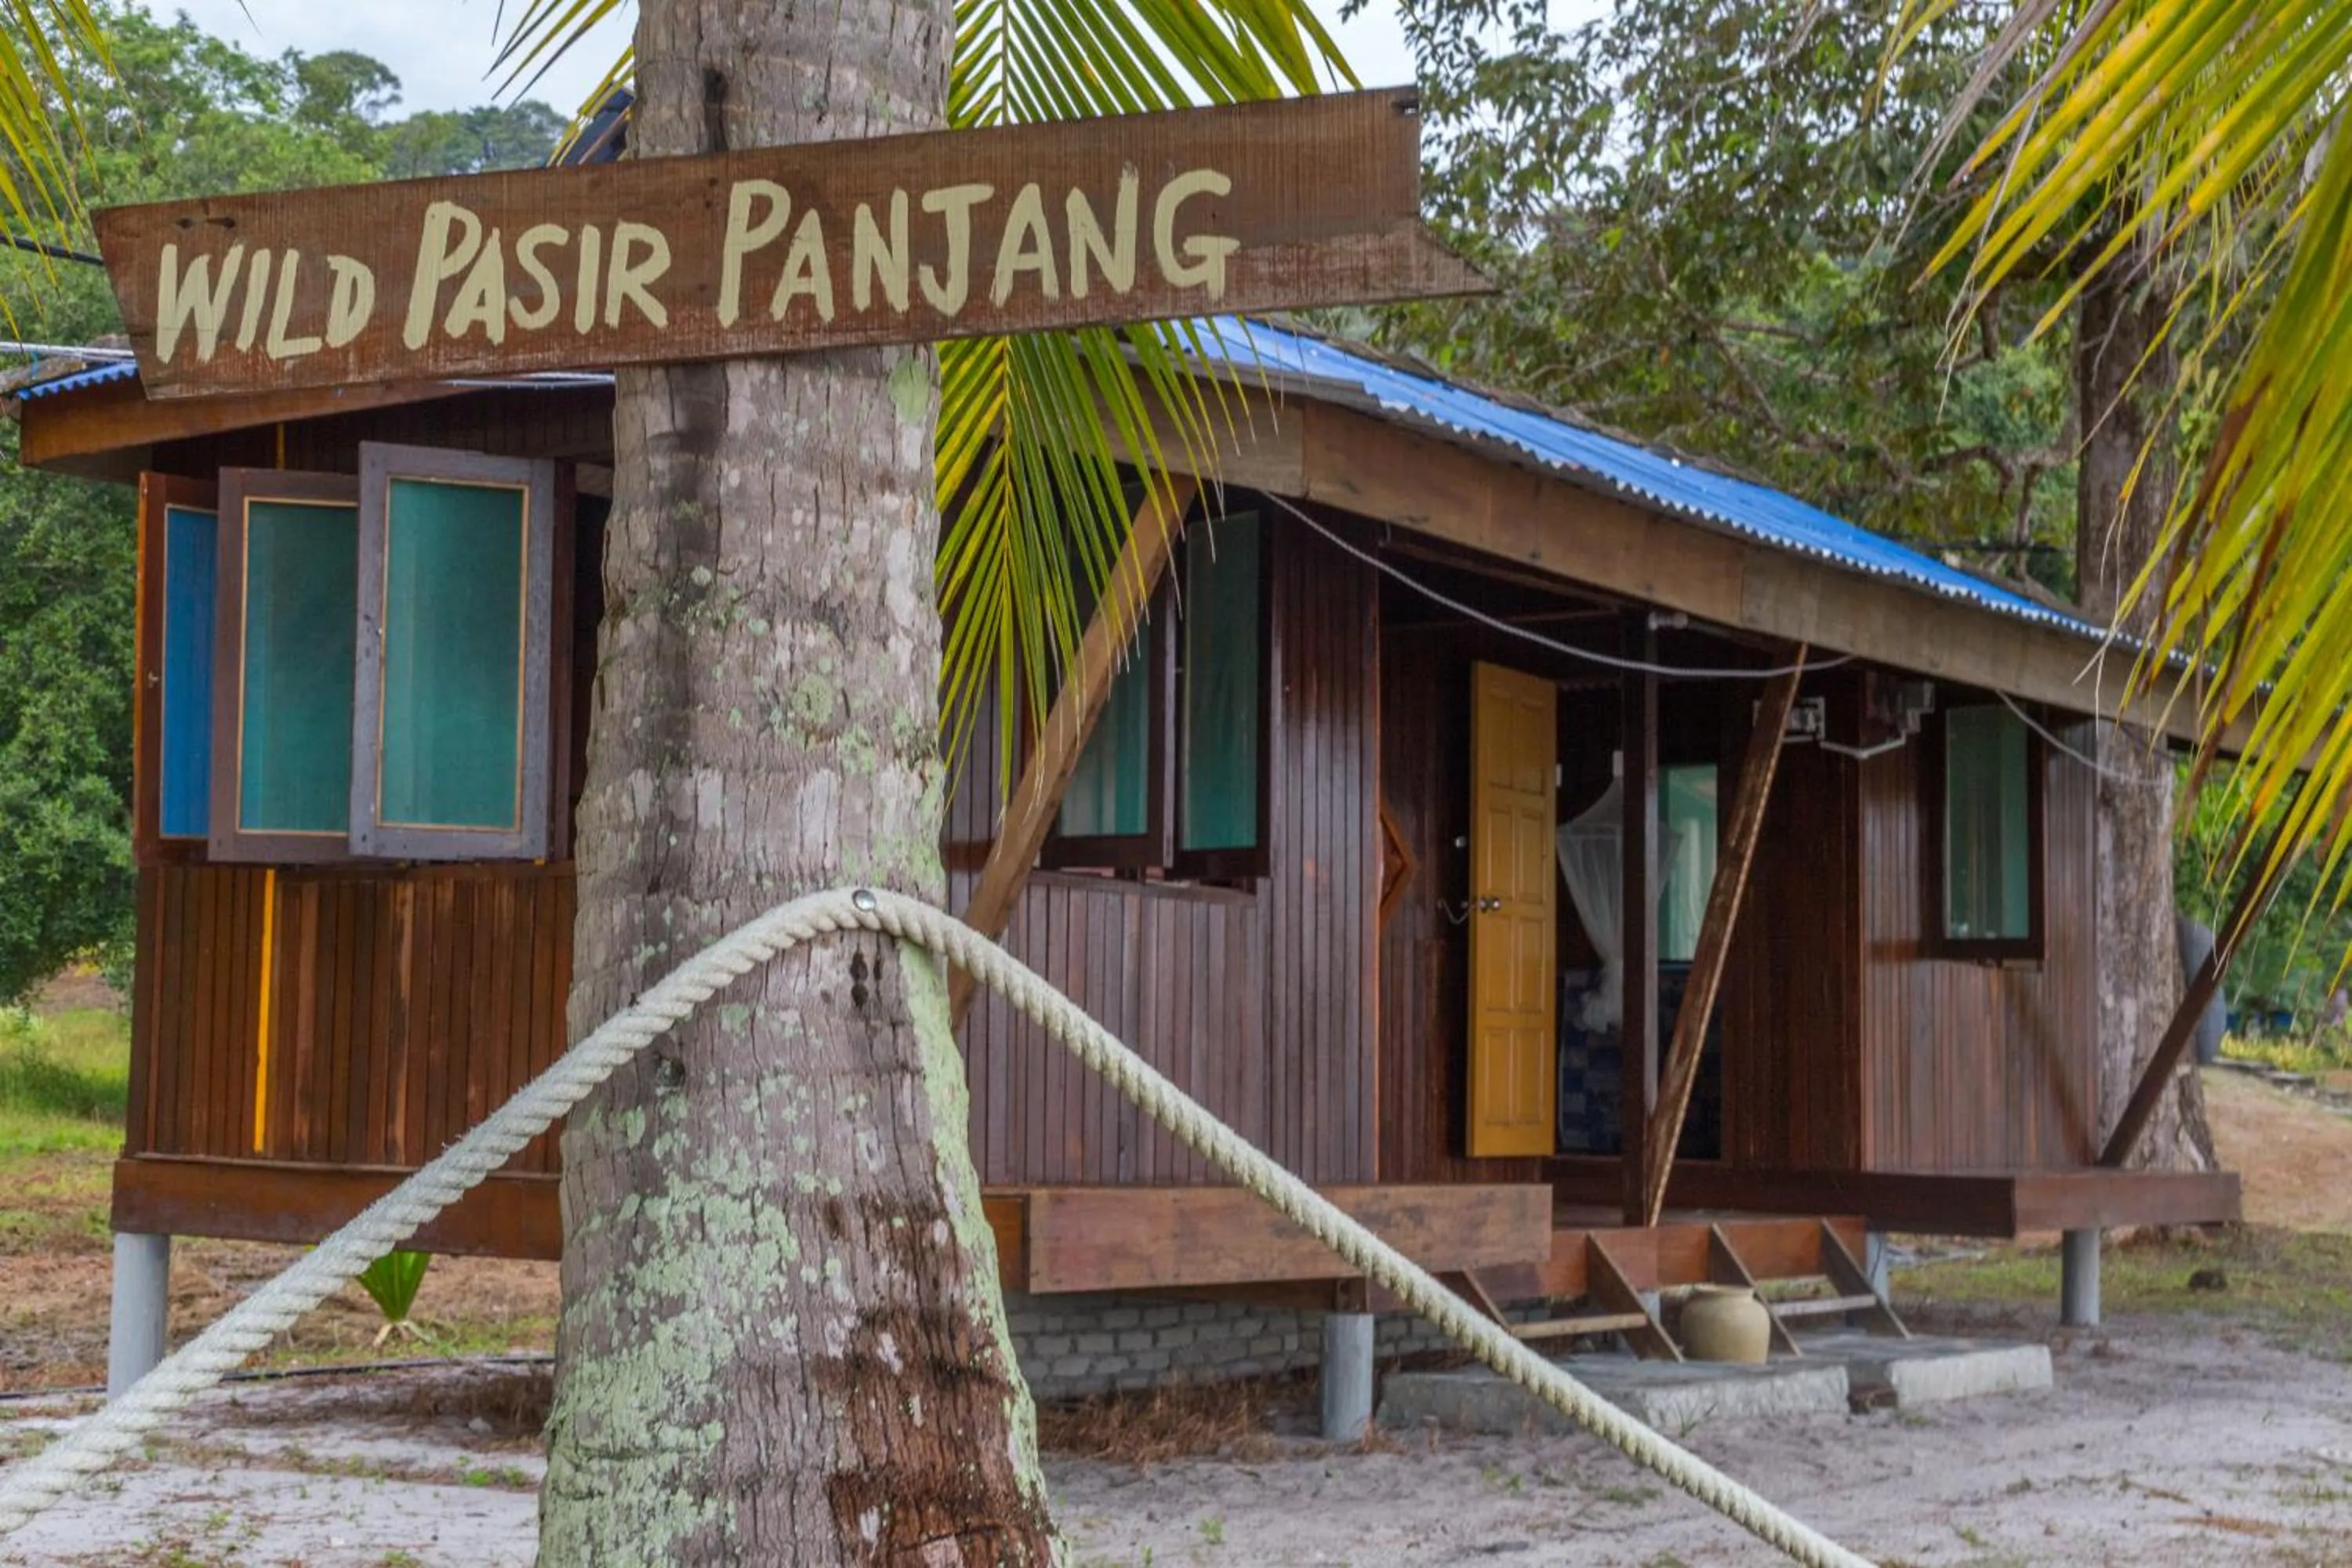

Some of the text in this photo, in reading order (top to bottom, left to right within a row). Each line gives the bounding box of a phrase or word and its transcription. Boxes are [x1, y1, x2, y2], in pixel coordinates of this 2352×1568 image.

[157, 161, 1241, 364] WILD PASIR PANJANG
